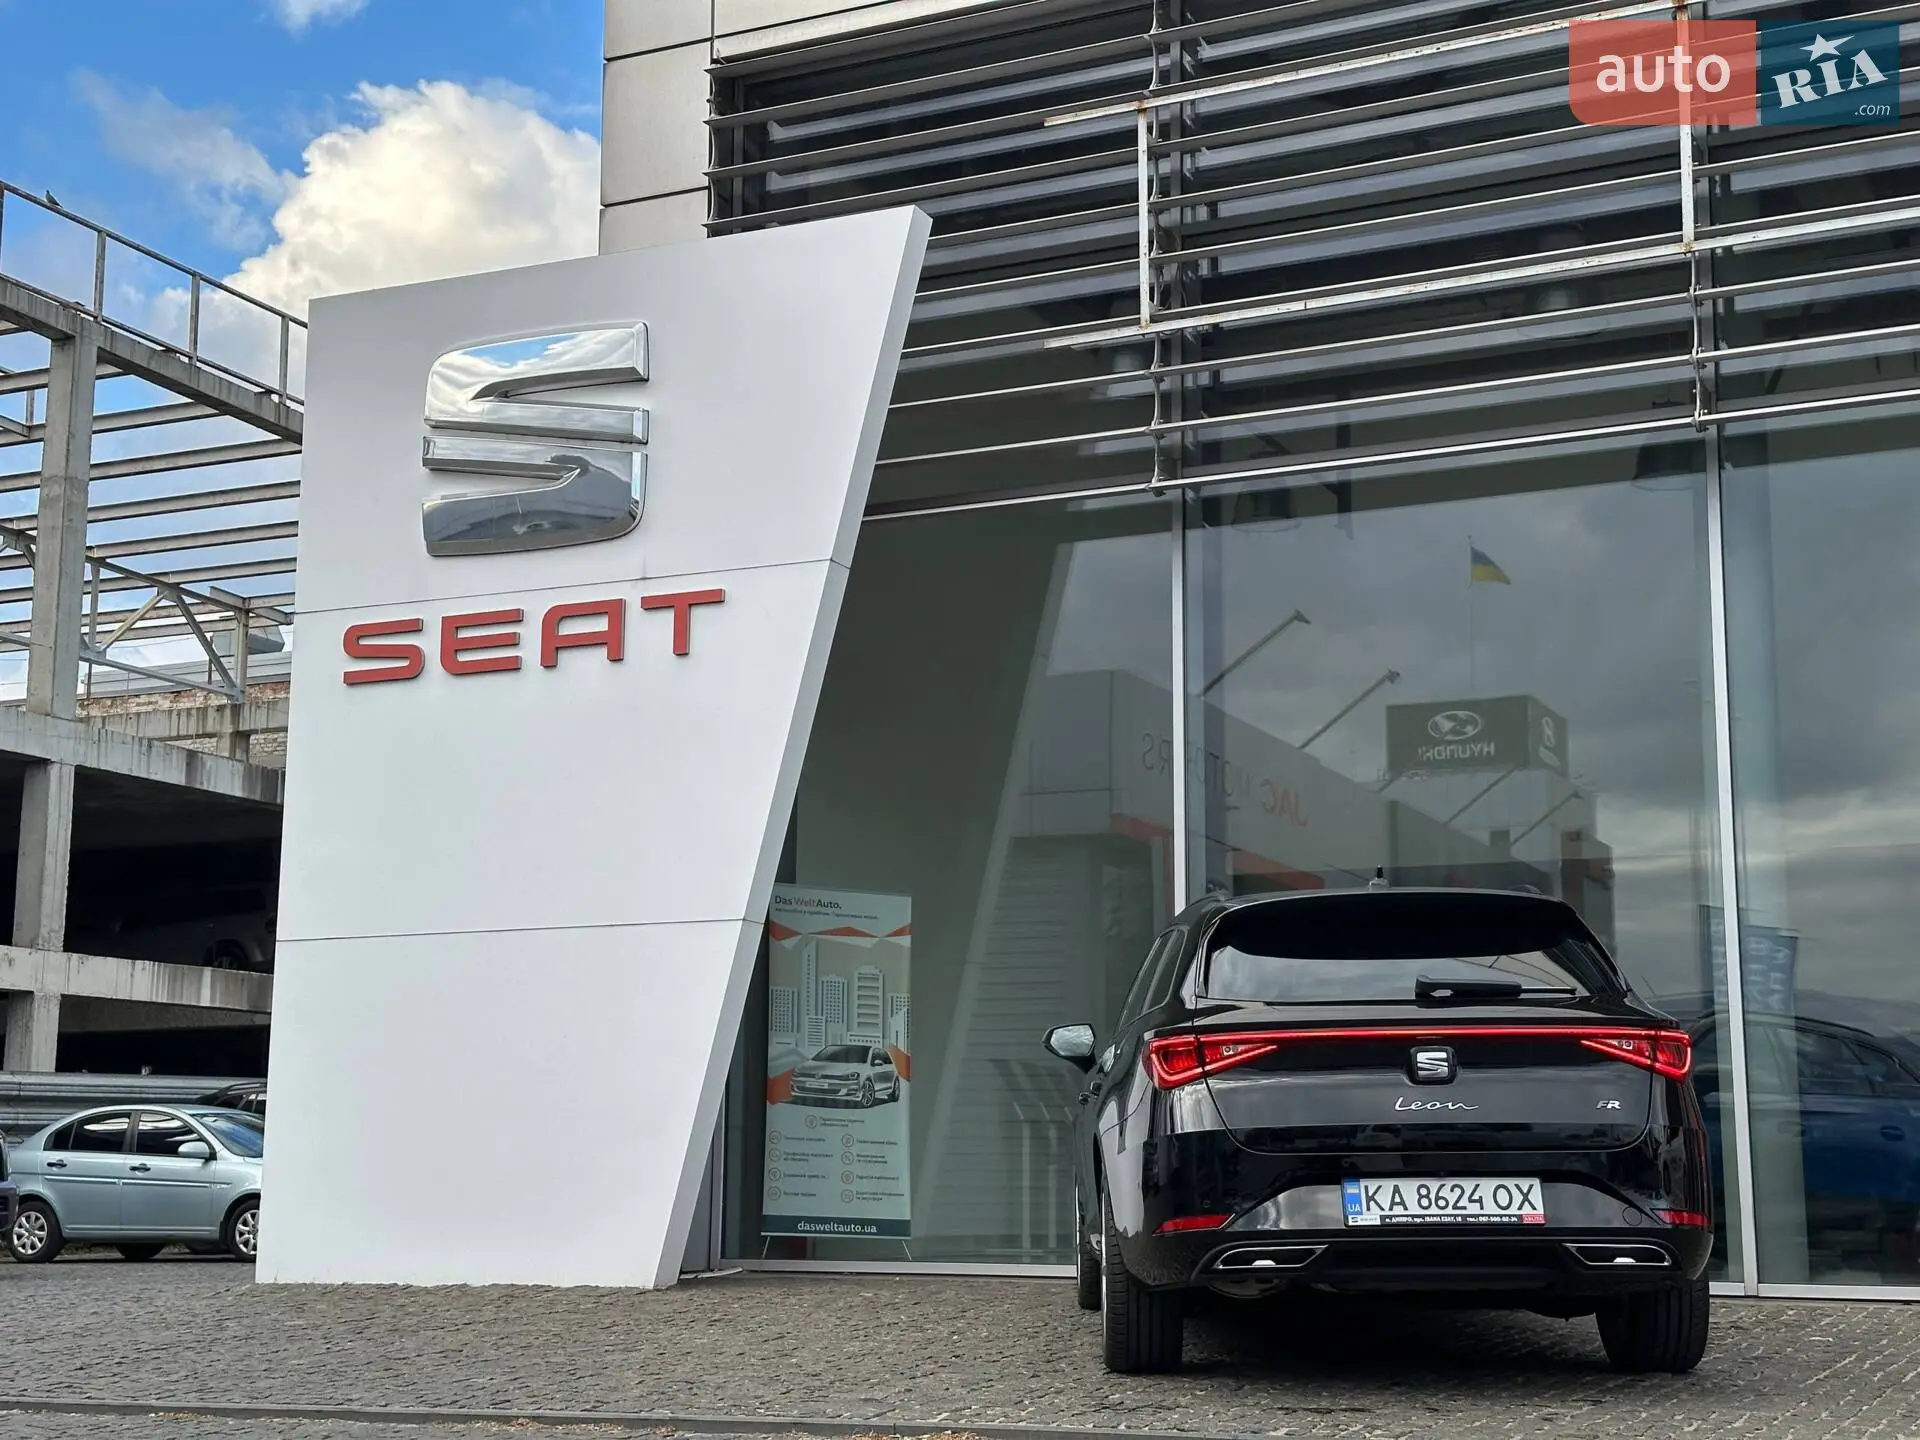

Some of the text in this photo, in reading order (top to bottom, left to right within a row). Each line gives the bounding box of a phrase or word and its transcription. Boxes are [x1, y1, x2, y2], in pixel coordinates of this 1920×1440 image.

[343, 588, 726, 686] SEAT
[1394, 1096, 1621, 1111] Leon FR
[1364, 1183, 1538, 1212] KA 8624 OX
[1347, 1204, 1362, 1213] UA
[797, 1220, 877, 1233] dasweltauto.ua
